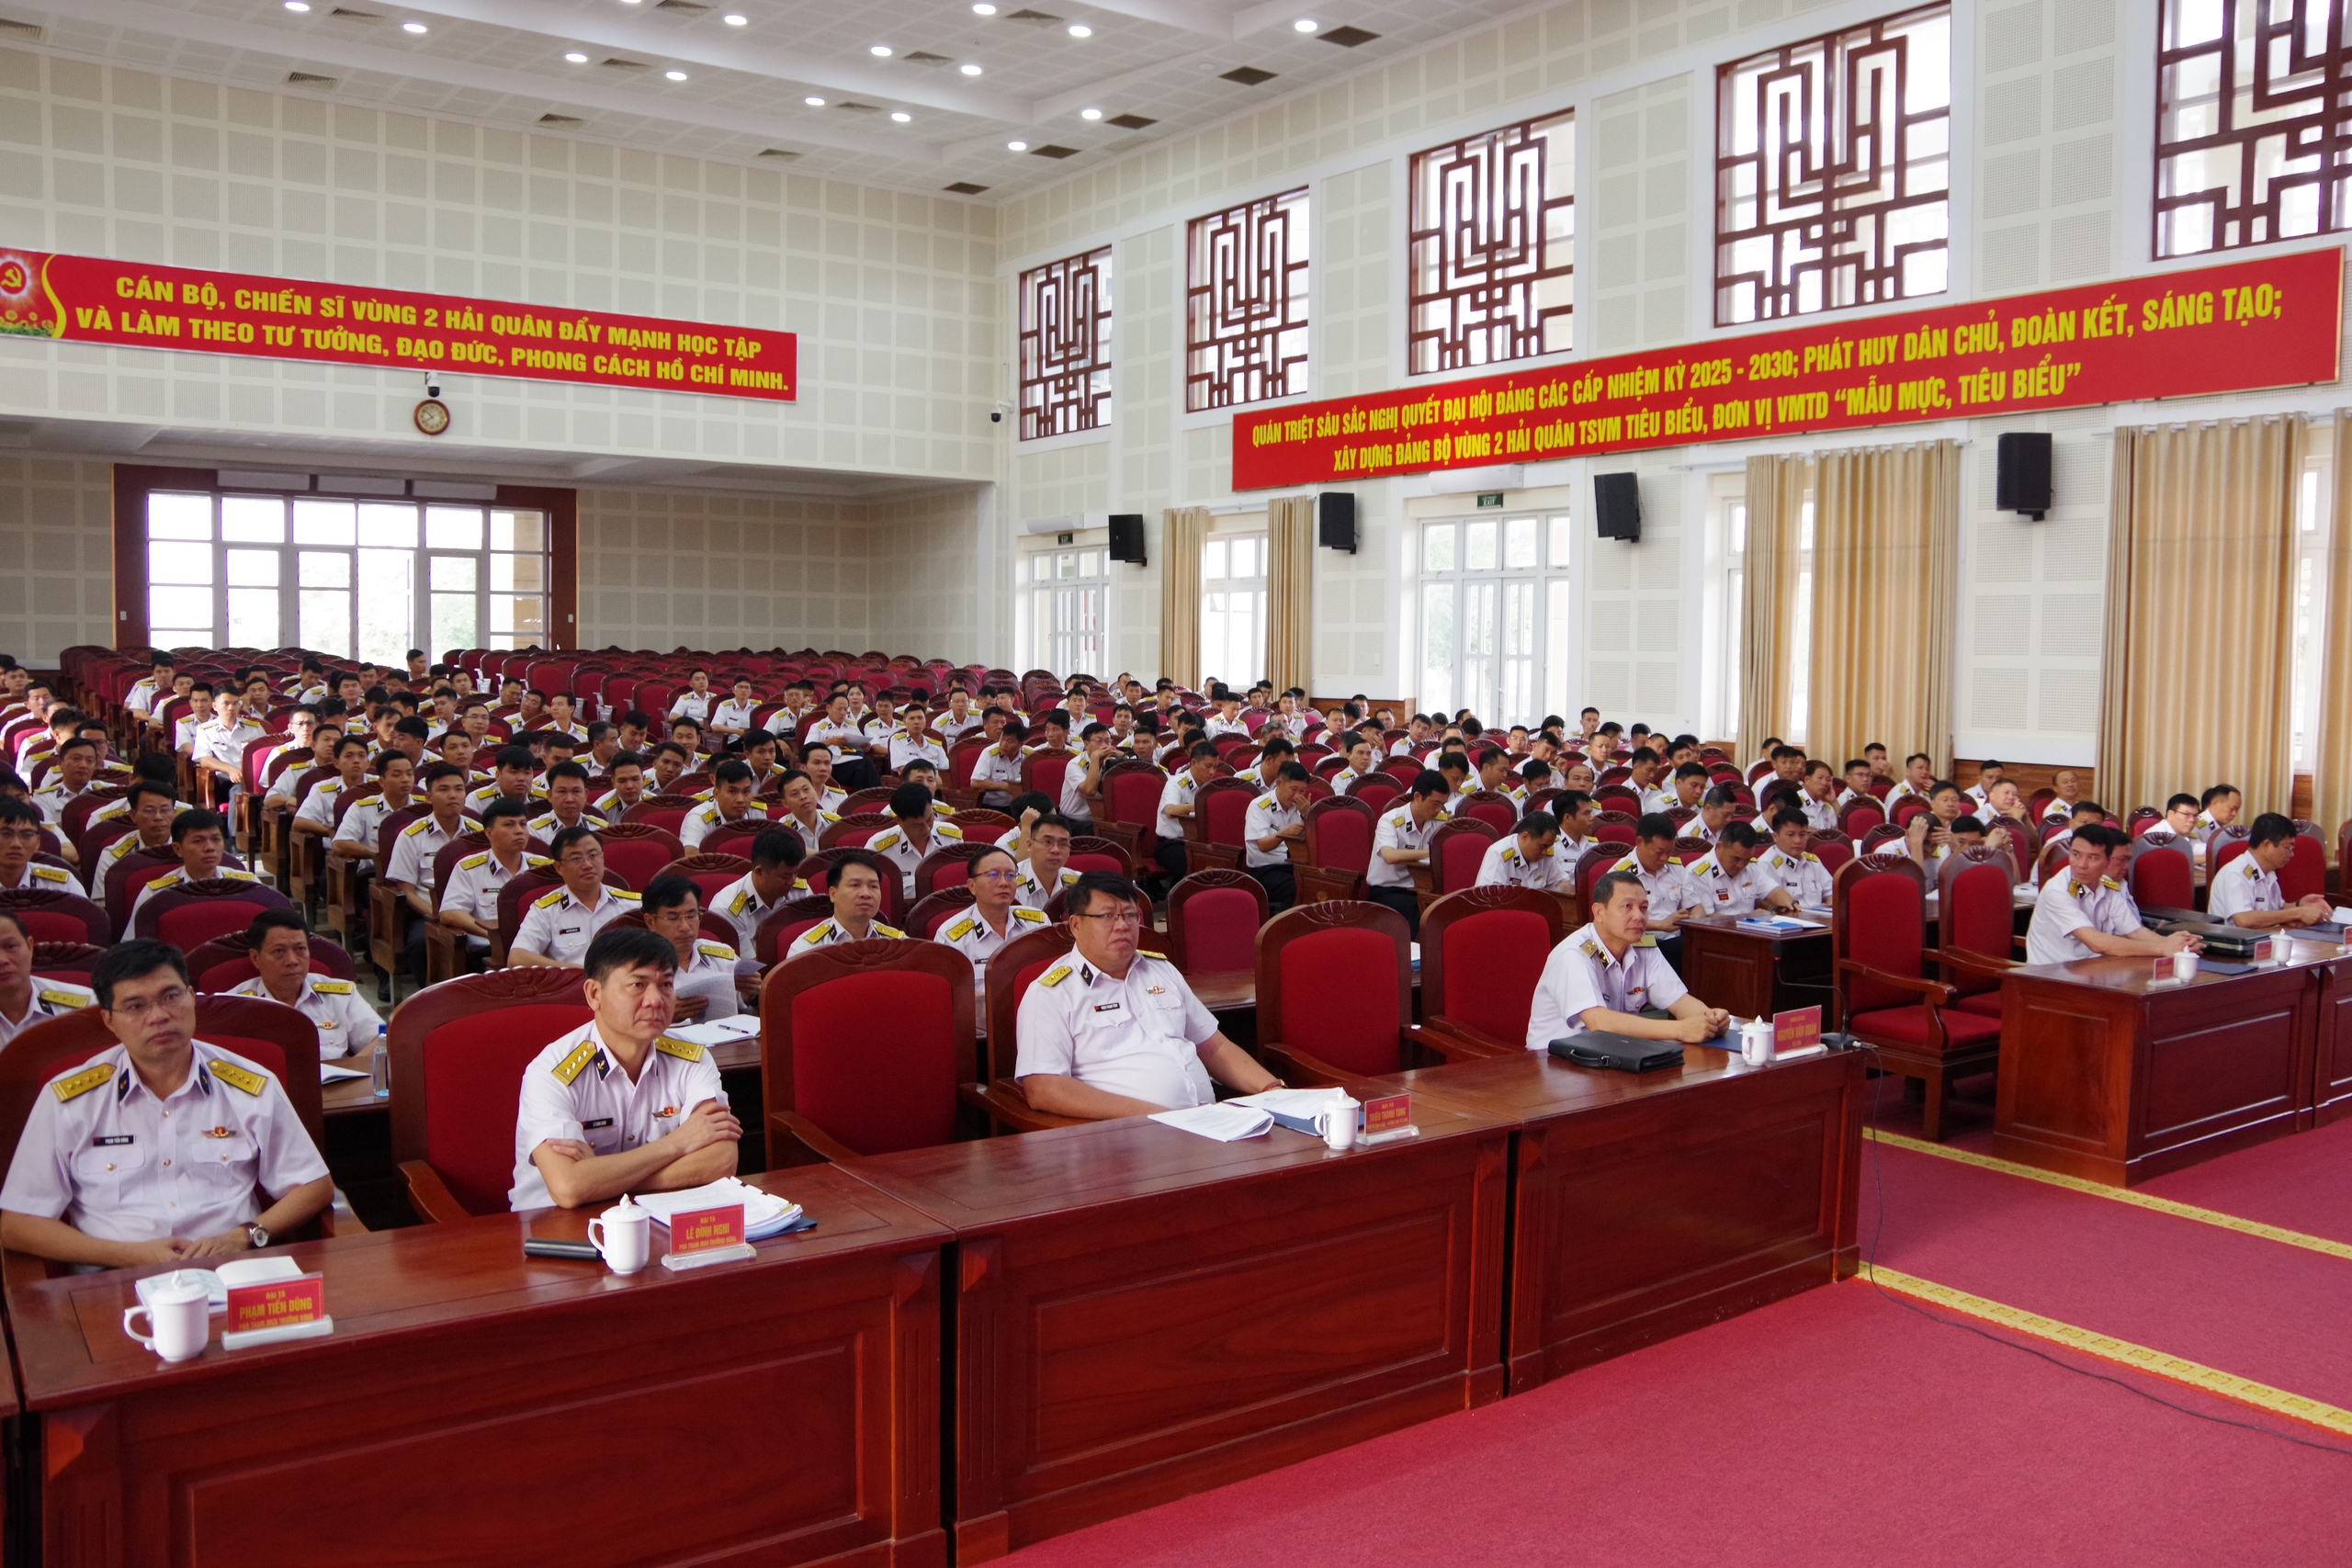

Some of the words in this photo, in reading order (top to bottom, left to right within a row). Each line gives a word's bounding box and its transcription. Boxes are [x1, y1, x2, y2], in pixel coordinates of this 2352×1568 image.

[76, 305, 112, 330] VÀ
[122, 310, 179, 336] LÀM
[188, 319, 254, 343] THEO
[262, 325, 296, 346] TƯ
[300, 325, 389, 356] TƯỞNG,
[396, 337, 444, 362] ĐẠO
[451, 340, 503, 367] ĐỨC,
[512, 347, 586, 371] PHONG
[594, 354, 650, 378] CÁCH
[657, 357, 684, 380] HỒ
[691, 364, 723, 384] CHÍ
[730, 368, 788, 390] MINH.
[117, 276, 173, 301] CÁN
[183, 282, 225, 310] BỘ,
[235, 288, 311, 315] CHIẾN
[320, 296, 345, 318] SĨ
[352, 299, 416, 325] VÙNG
[424, 309, 438, 327] 2
[446, 306, 483, 332] HẢI
[492, 314, 552, 338] QUÂN
[559, 317, 601, 343] ĐẨY
[608, 327, 671, 350] MẠNH
[678, 334, 718, 356] HỌC
[724, 337, 761, 361] TẬP
[1253, 420, 1282, 447] QUÁN
[1284, 414, 1314, 444] TRIỆT
[1317, 412, 1340, 437] SÂU
[1342, 405, 1365, 434] SẮC
[1369, 407, 1397, 433] NGHỊ
[1402, 393, 1441, 429] QUYẾT
[1443, 397, 1465, 425] ĐẠI
[1469, 389, 1492, 422] HỘI
[1496, 380, 1534, 414] ĐẢNG
[1539, 378, 1568, 409] CÁC
[1573, 369, 1603, 404] CẤP
[1608, 366, 1659, 400] NHIỆM
[1665, 360, 1686, 391] KỲ
[1690, 358, 1732, 389] 2025
[1749, 350, 1798, 380] 2030;
[1804, 337, 1854, 373] PHÁT
[1859, 334, 1898, 367] HUY
[1904, 324, 1948, 361] DÂN
[1954, 310, 2005, 355] CHỦ,
[2011, 307, 2075, 347] ĐOÀN
[2083, 294, 2133, 339] KẾT,
[2142, 290, 2213, 332] SÁNG
[2222, 284, 2281, 326] TẠO;
[1334, 446, 1357, 471] XÂY
[1360, 444, 1392, 472] DỰNG
[1396, 433, 1430, 465] ĐẢNG
[1433, 433, 1451, 465] BỘ
[1454, 431, 1490, 459] VÙNG
[1494, 432, 1503, 455] 2
[1507, 419, 1530, 453] HẢI
[1534, 419, 1575, 452] QUÂN
[1579, 416, 1621, 445] TSVM
[1625, 408, 1660, 439] TIÊU
[1665, 397, 1708, 435] BIỂU,
[1713, 400, 1749, 430] ĐƠN
[1755, 398, 1771, 430] VỊ
[1777, 391, 1828, 423] VMTD
[1835, 375, 1892, 415] “MẪU
[1898, 377, 1951, 414] MỰC,
[1958, 367, 2006, 404] TIÊU
[2012, 354, 2081, 399] BIỂU”
[240, 1303, 265, 1320] PHẠM
[268, 1299, 287, 1314] TIẾN
[289, 1296, 311, 1312] DŨNG
